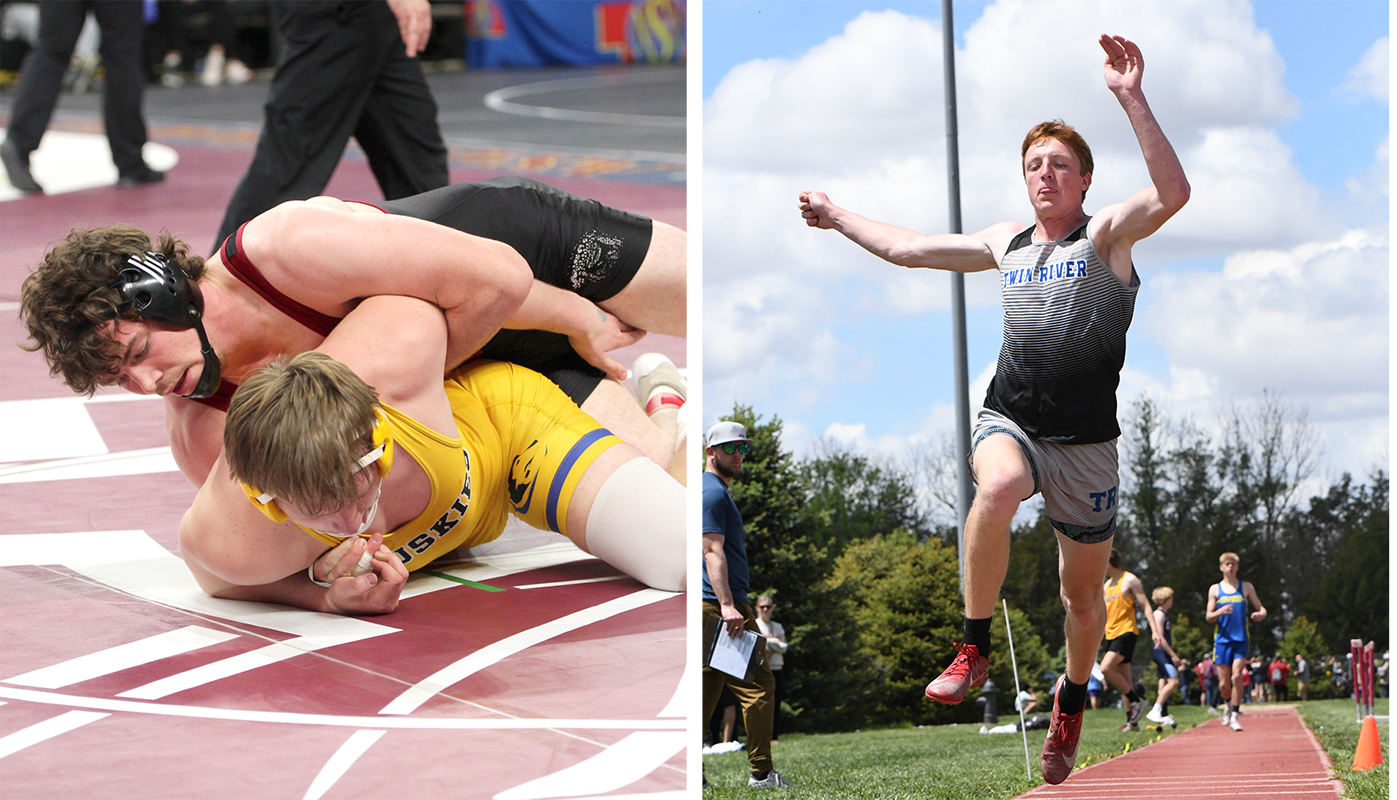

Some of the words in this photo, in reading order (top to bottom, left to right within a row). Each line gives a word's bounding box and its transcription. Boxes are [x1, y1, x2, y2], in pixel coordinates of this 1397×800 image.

[1003, 265, 1034, 288] TWIN
[1039, 259, 1088, 282] RIVER
[393, 447, 473, 566] USKIES
[1089, 485, 1117, 512] TR
